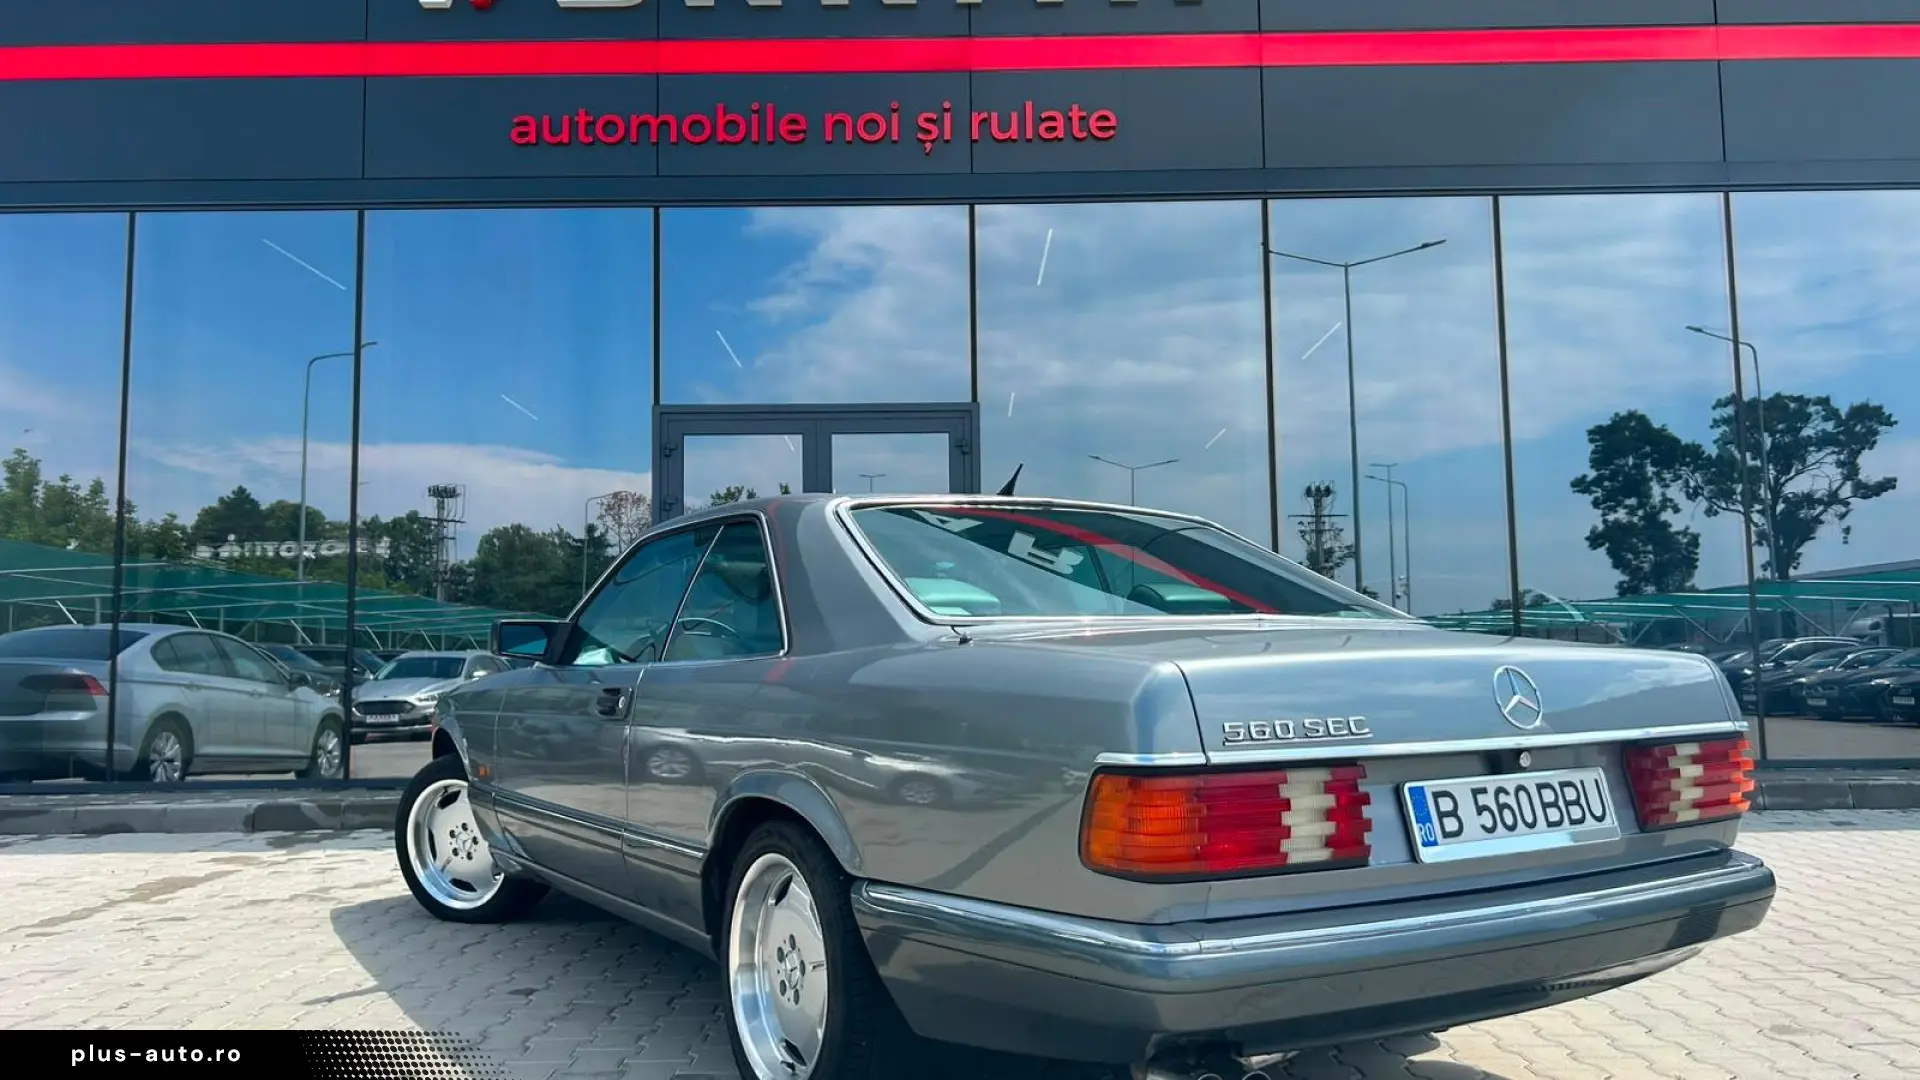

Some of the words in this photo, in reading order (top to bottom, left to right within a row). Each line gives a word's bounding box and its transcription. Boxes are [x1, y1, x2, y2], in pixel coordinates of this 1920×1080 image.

[509, 102, 808, 145] automobile
[824, 101, 899, 141] noi
[916, 100, 951, 154] și
[971, 100, 1118, 140] rulate
[1223, 719, 1296, 742] 560
[1303, 716, 1371, 738] SEC
[1417, 822, 1435, 842] RO
[1431, 790, 1464, 839] B
